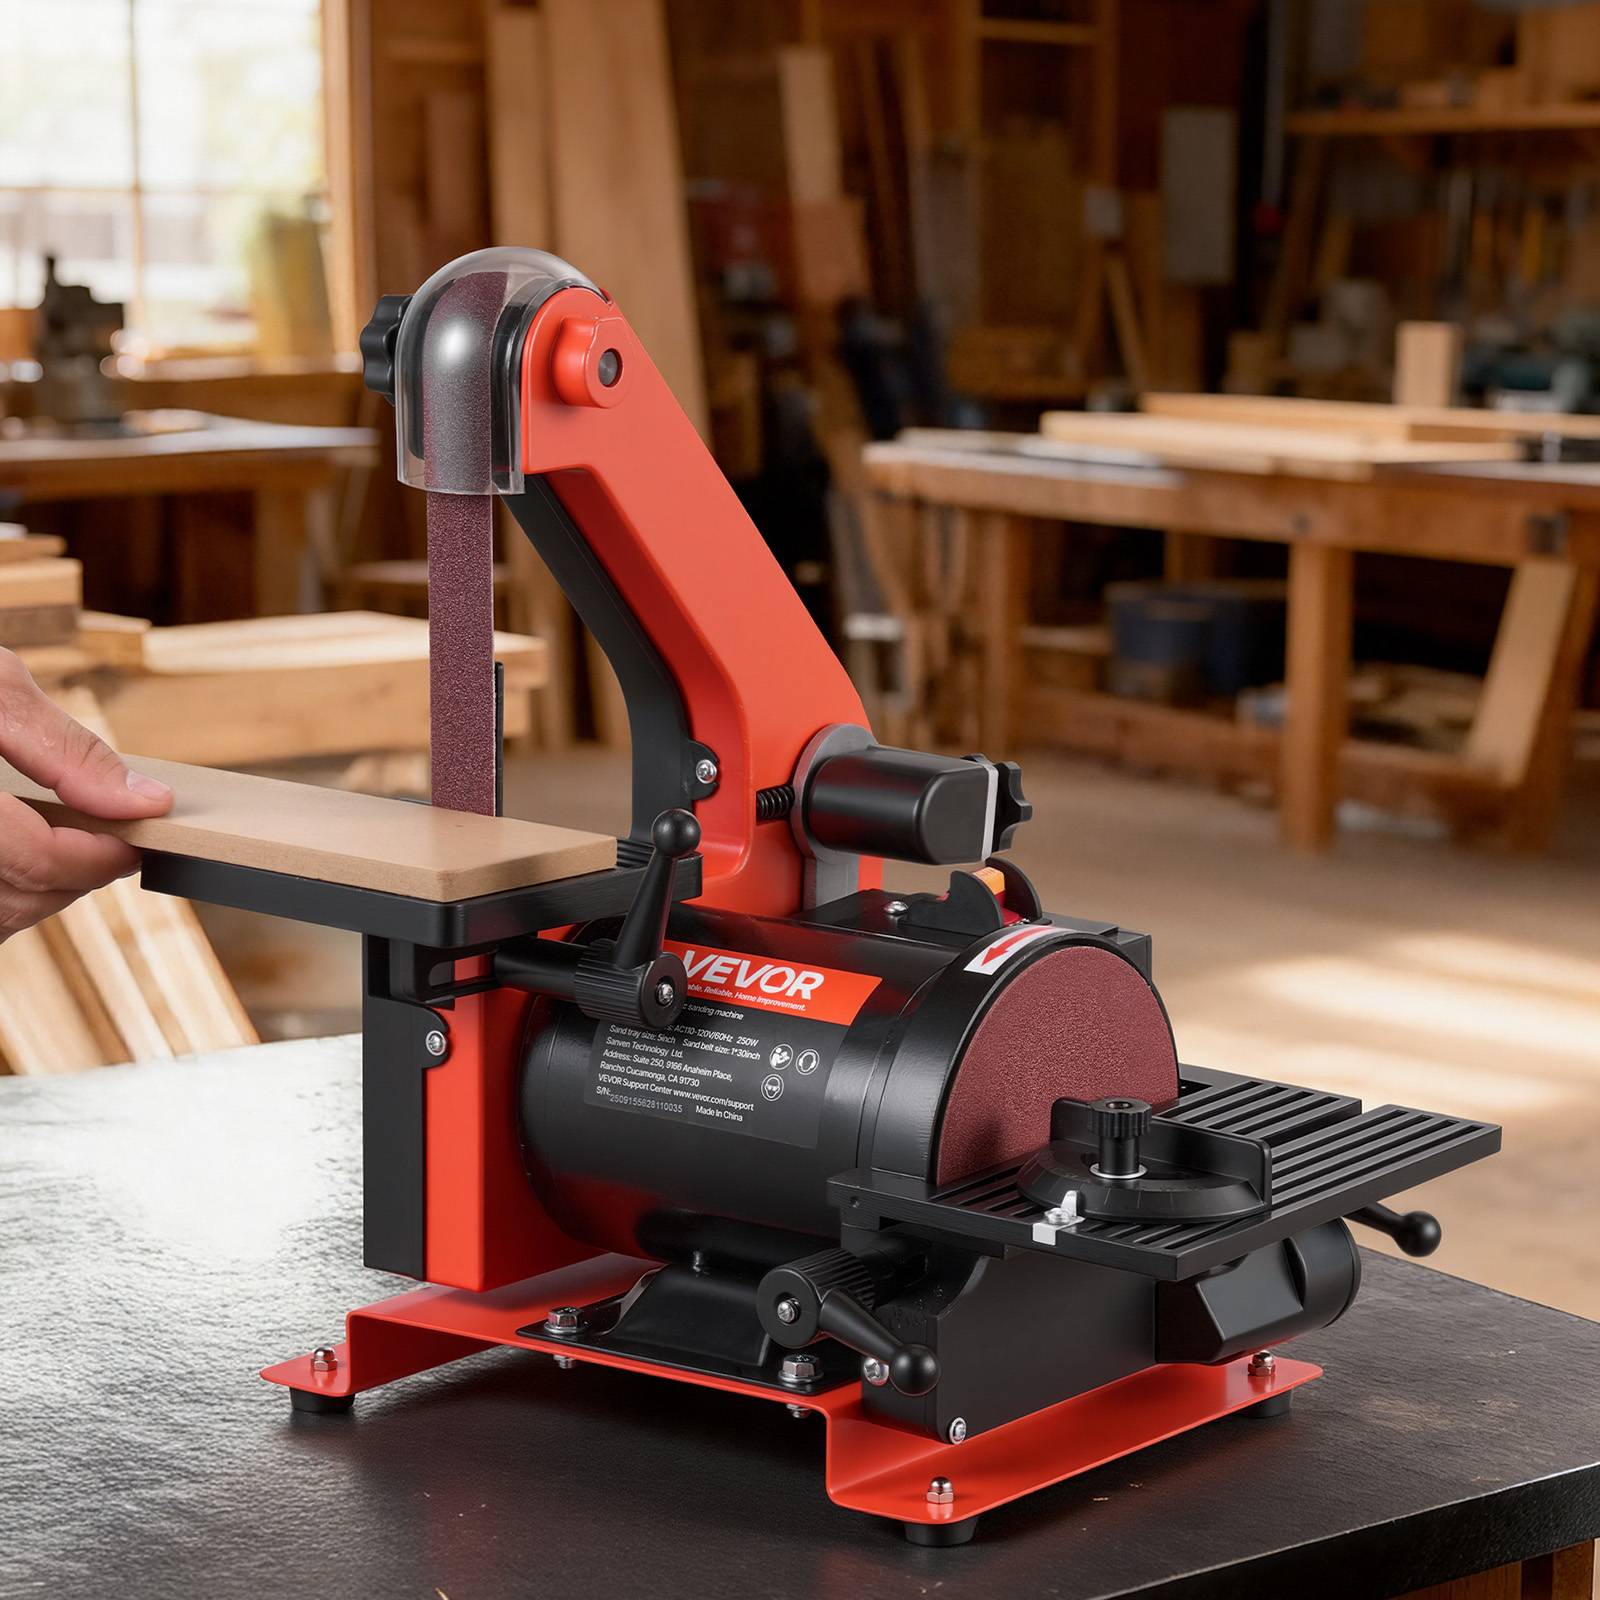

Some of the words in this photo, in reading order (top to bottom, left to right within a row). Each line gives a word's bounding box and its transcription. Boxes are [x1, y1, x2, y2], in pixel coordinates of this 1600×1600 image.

[683, 949, 824, 1000] VEVOR
[688, 1004, 714, 1016] sanding
[714, 1009, 744, 1020] machine
[703, 985, 734, 999] Reliable.
[735, 991, 757, 1003] Home
[756, 995, 806, 1012] Improvement.
[606, 1036, 631, 1048] Sanven
[632, 1041, 669, 1057] Technology
[670, 1049, 684, 1059] Ltd.
[609, 1024, 628, 1035] Sand
[627, 1028, 641, 1039] tray
[641, 1030, 656, 1041] size:
[657, 1033, 676, 1044] 5inch
[682, 1038, 701, 1049] Sand
[700, 1041, 714, 1052] belt
[714, 1045, 730, 1055] size:
[674, 1024, 734, 1043] AC110-120V/60Hz
[736, 1036, 759, 1047] 250W
[600, 1060, 625, 1073] Rancho
[625, 1066, 667, 1082] Cucamonga,
[667, 1074, 678, 1083] CA
[679, 1076, 700, 1087] 91730
[603, 1048, 632, 1061] Address:
[632, 1054, 650, 1065] Suite
[650, 1058, 665, 1069] 250,
[665, 1060, 682, 1071] 9166
[682, 1064, 712, 1077] Anaheim
[712, 1069, 733, 1082] Place,
[596, 1085, 611, 1096] S/N:
[695, 1105, 715, 1117] Made
[723, 1110, 743, 1122] China
[598, 1073, 622, 1085] VEVOR
[622, 1078, 649, 1090] Support
[649, 1083, 673, 1095] Center
[673, 1089, 754, 1111] www.vevor.com/support
